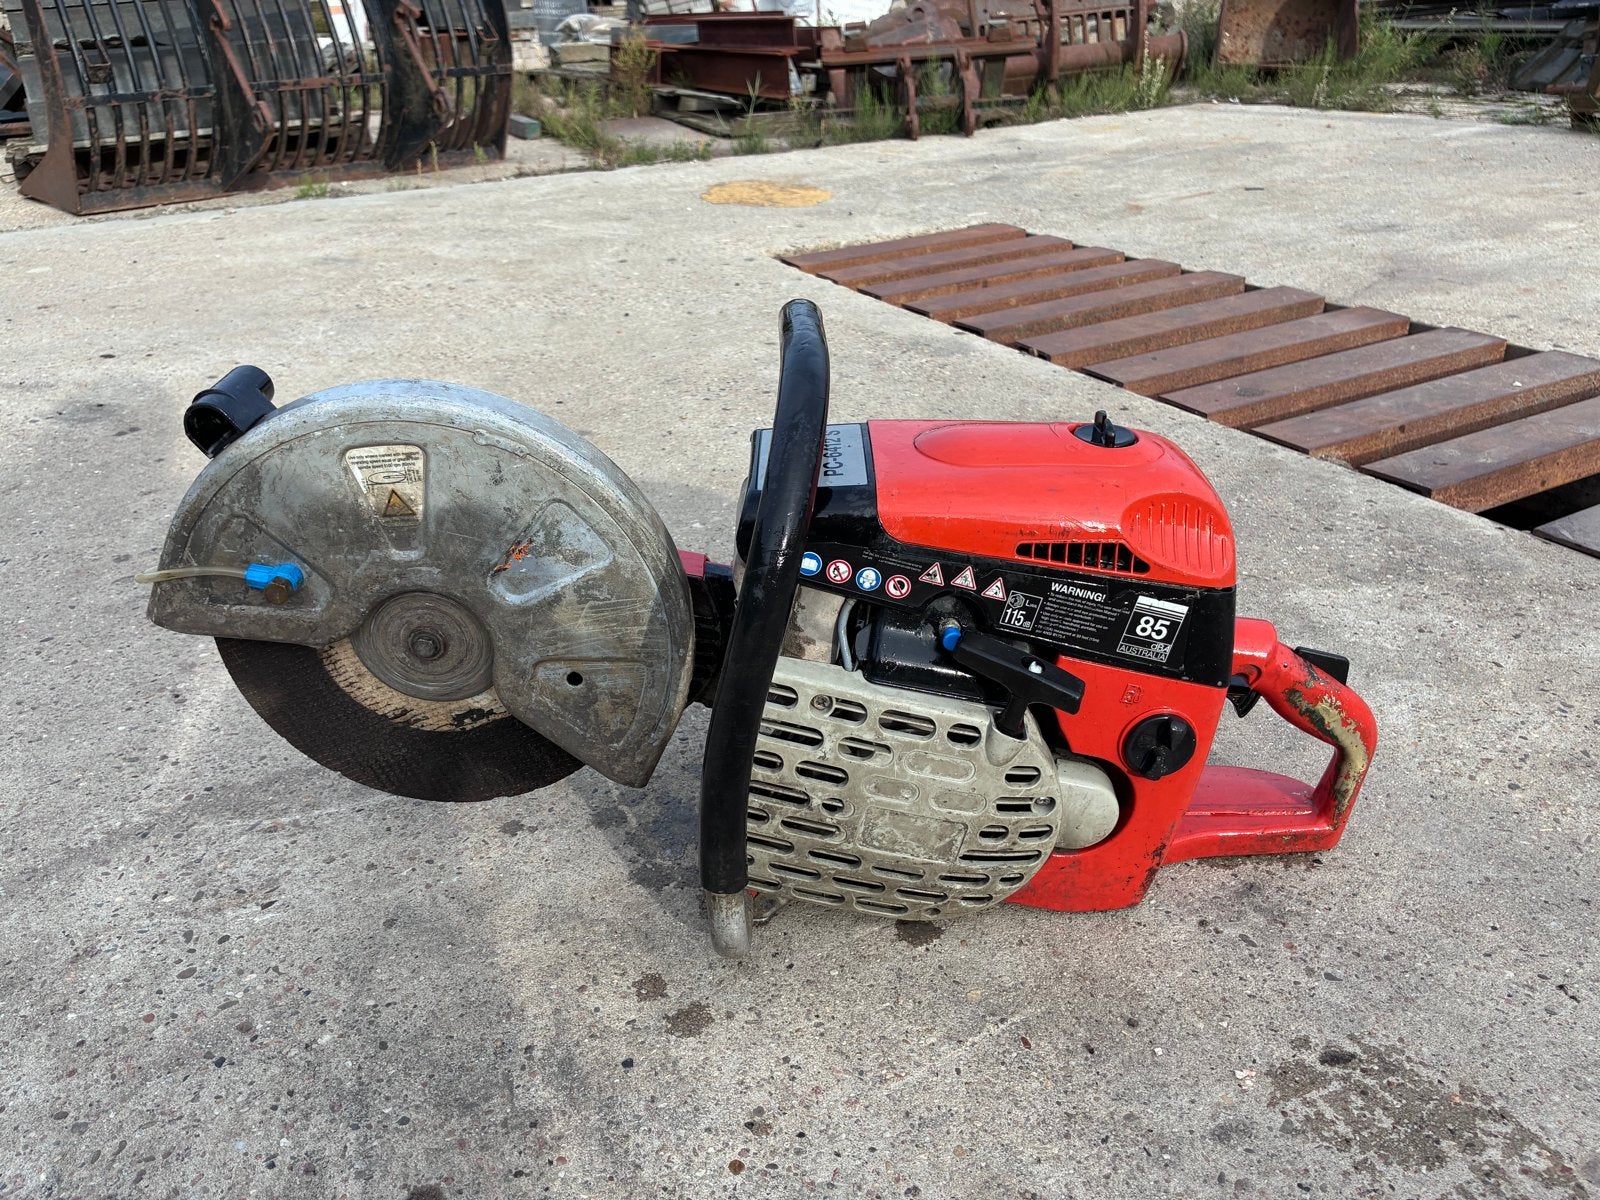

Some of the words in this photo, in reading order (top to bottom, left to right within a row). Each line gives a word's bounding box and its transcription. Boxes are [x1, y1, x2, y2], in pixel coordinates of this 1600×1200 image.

[822, 438, 844, 476] PC-6412
[1051, 582, 1106, 602] WARNING!
[1004, 608, 1026, 626] 115
[1136, 616, 1171, 640] 85
[1120, 644, 1165, 660] AUSTRALIA
